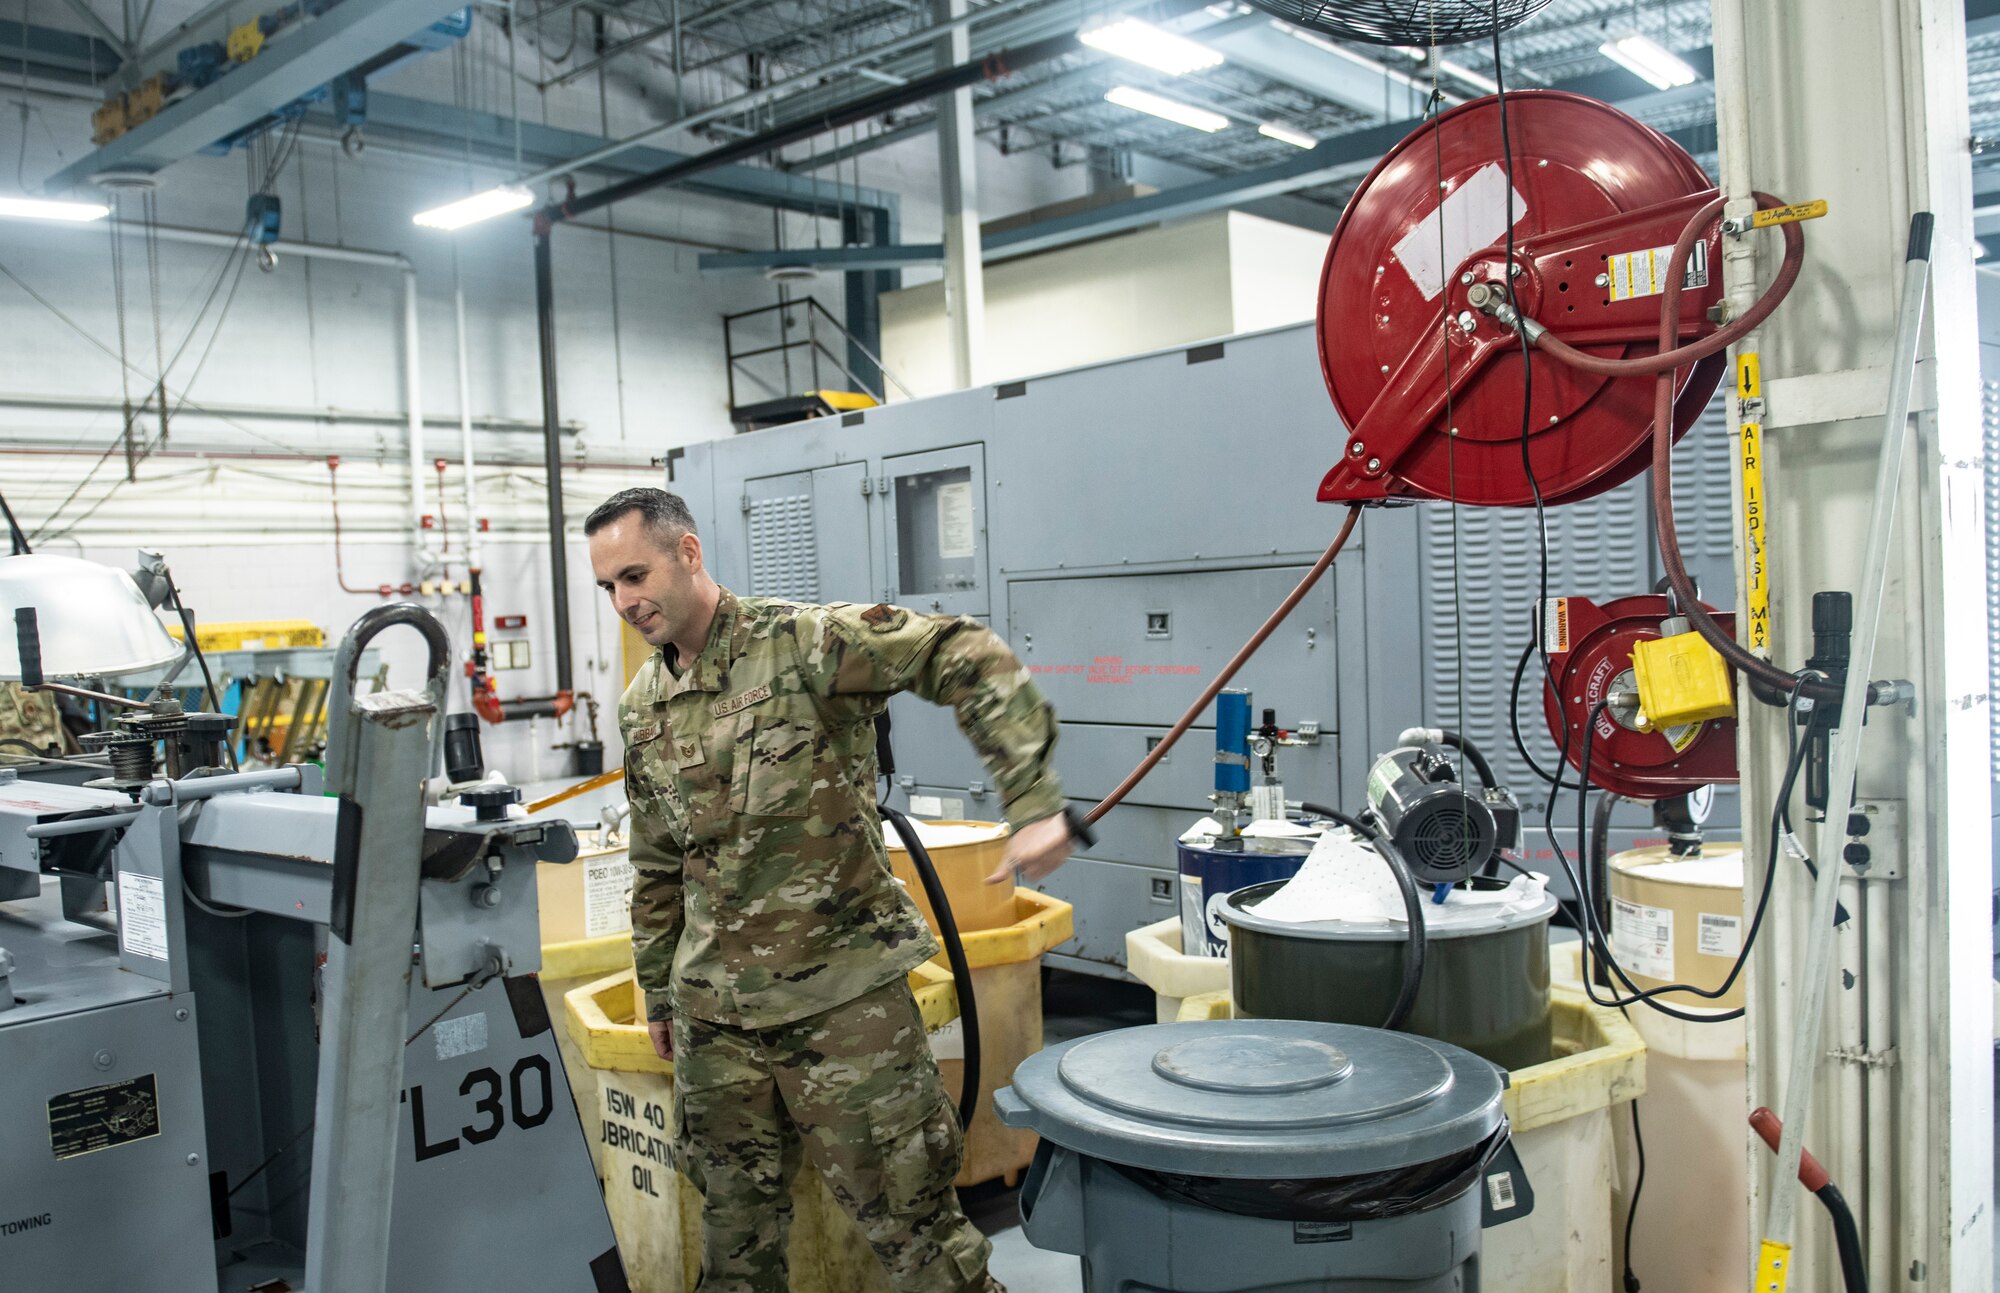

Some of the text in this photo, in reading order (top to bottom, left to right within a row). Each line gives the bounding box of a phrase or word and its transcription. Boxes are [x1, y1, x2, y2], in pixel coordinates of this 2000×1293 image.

[1744, 426, 1756, 470] AIR
[1751, 606, 1767, 648] MAX
[1558, 611, 1567, 646] WARNING
[714, 685, 769, 716] U.S. AIR FORCE
[401, 1054, 553, 1162] L30
[644, 1101, 665, 1131] 40
[632, 1165, 659, 1198] OIL
[0, 1212, 51, 1237] TOWING
